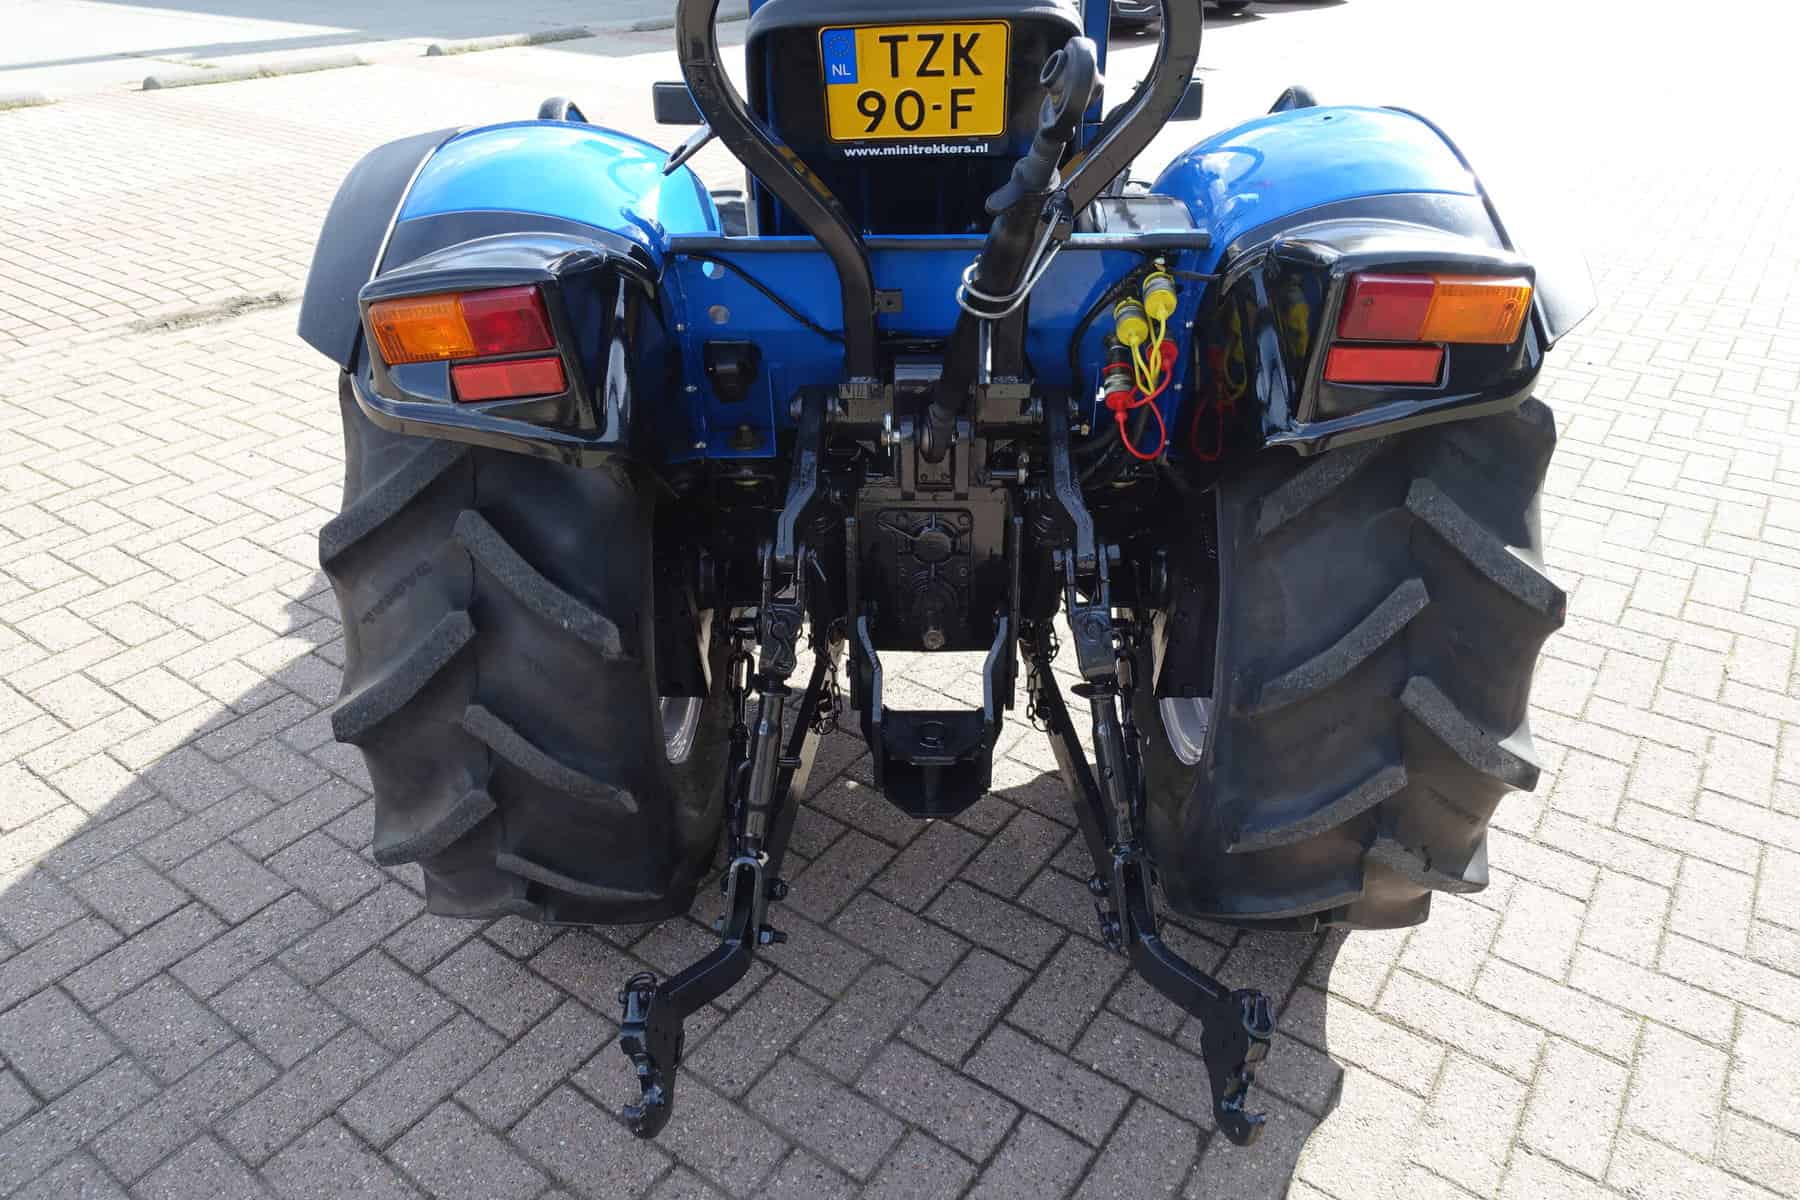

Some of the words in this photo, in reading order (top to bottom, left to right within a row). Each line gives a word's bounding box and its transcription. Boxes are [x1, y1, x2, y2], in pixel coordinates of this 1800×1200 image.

[832, 63, 851, 76] NL
[879, 33, 983, 78] TZK
[857, 88, 976, 132] 90-F
[844, 143, 989, 157] www.minitrekkers.nl
